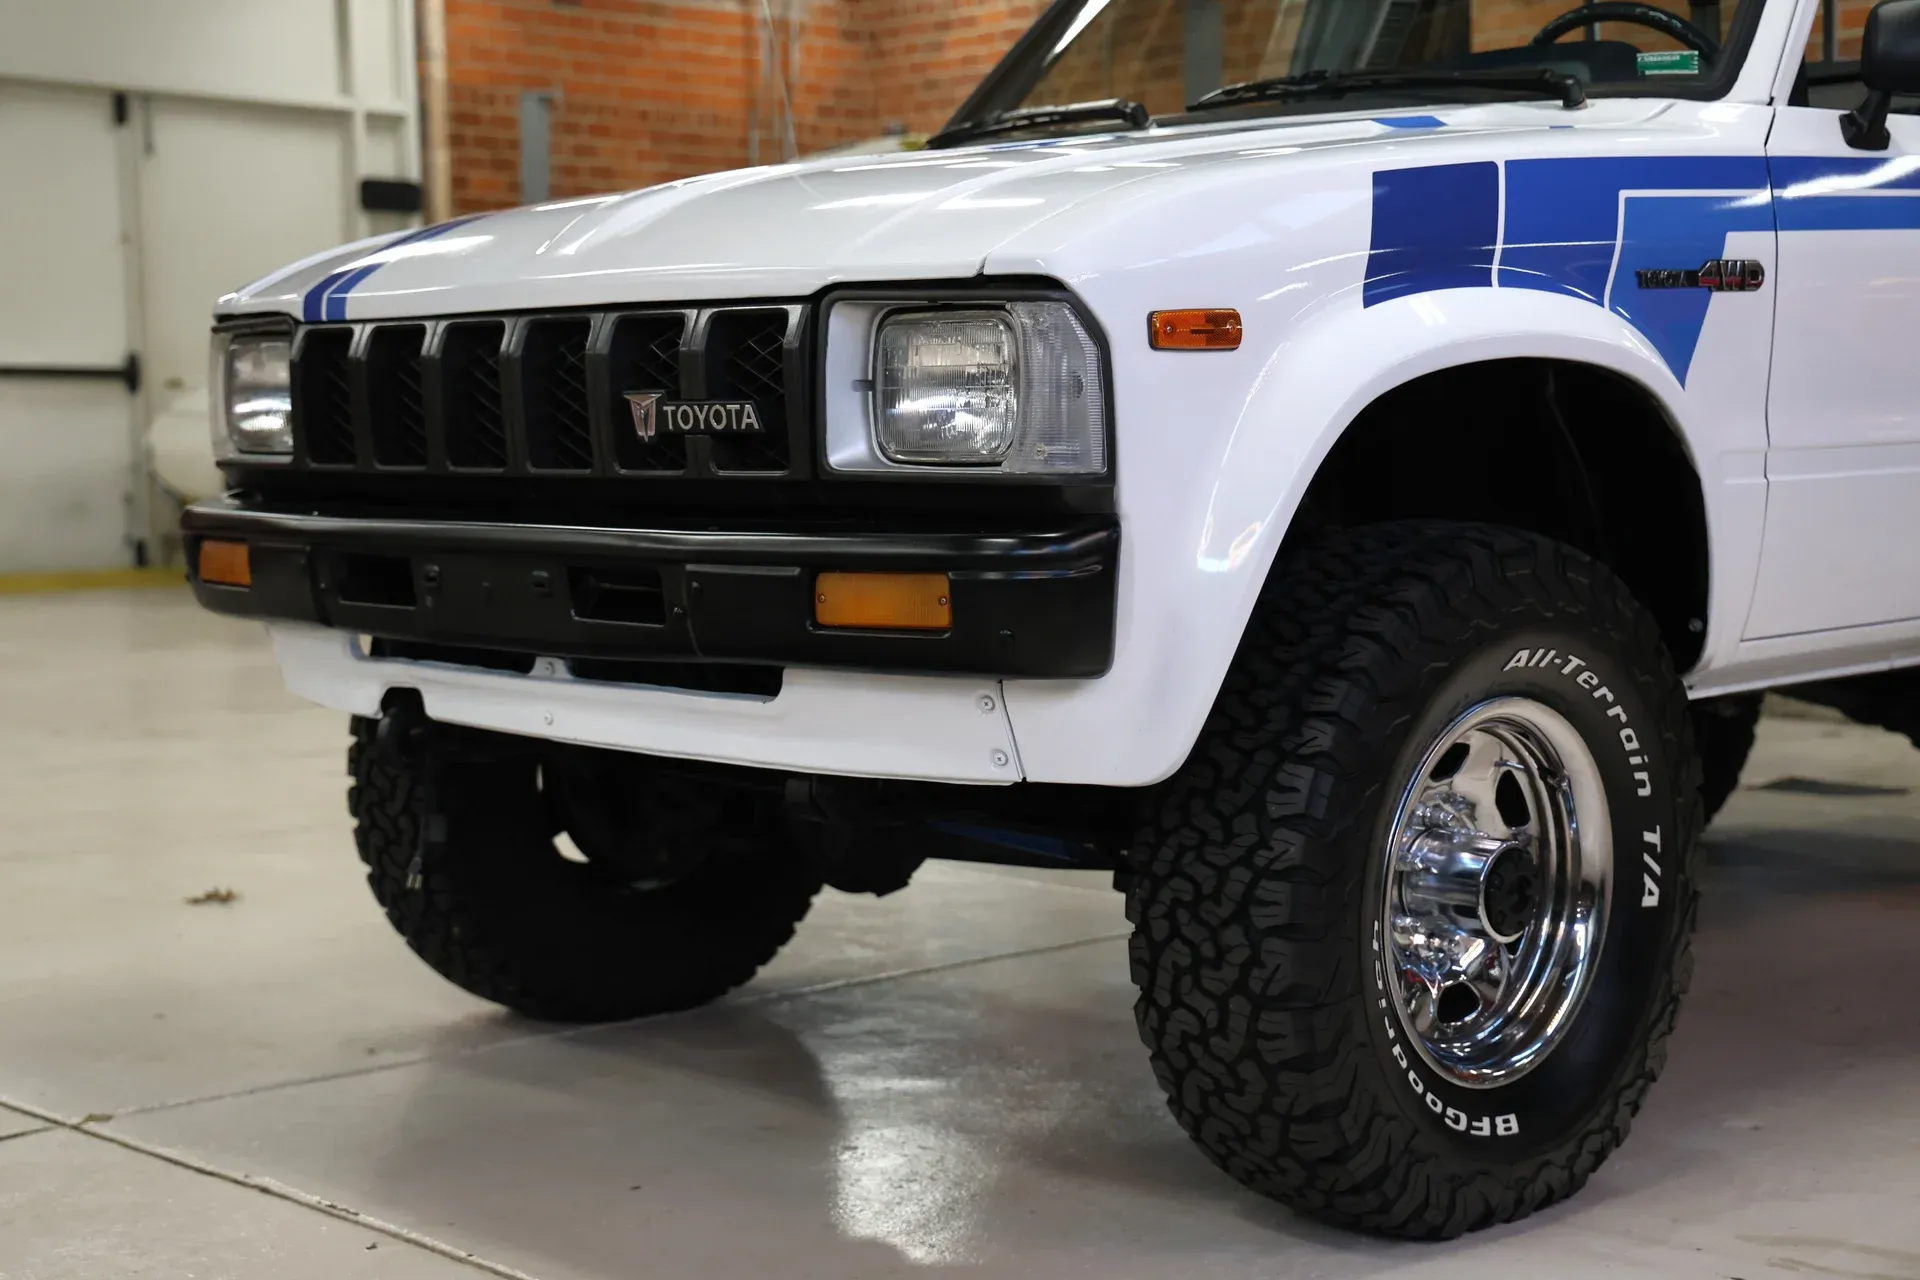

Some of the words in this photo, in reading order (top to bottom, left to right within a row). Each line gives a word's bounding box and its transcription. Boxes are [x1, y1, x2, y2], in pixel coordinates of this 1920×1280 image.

[1639, 269, 1688, 289] TOYOTA
[1698, 260, 1764, 292] 4WD
[663, 404, 760, 431] TOYOTA
[1503, 648, 1652, 797] All-Terrain
[1641, 824, 1662, 908] T/A
